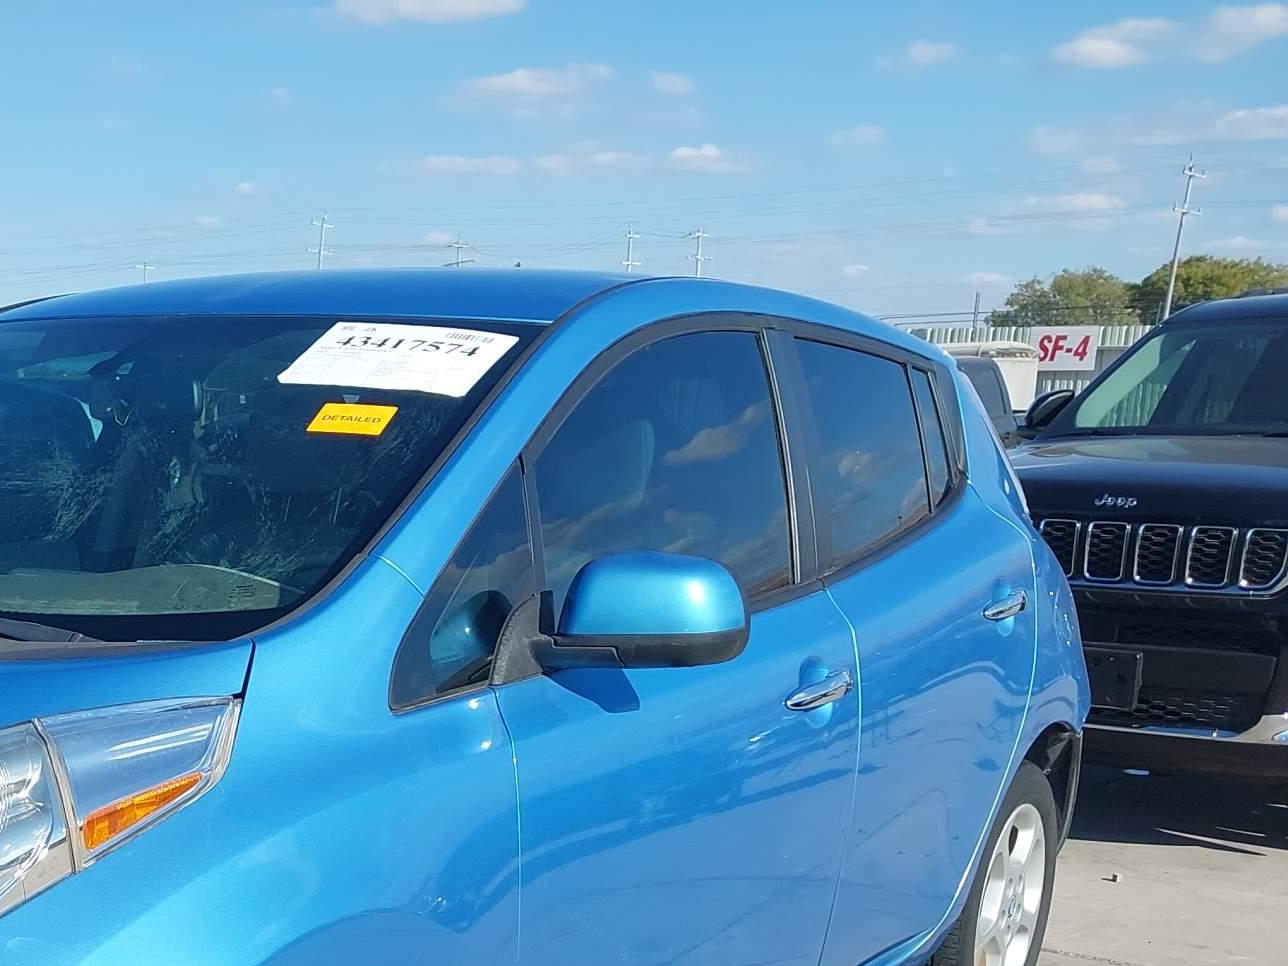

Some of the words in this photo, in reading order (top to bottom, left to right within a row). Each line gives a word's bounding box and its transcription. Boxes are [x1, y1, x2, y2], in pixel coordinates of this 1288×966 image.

[335, 335, 481, 357] 43417574
[1038, 334, 1091, 362] SF-4
[321, 414, 382, 423] DETAILED
[1094, 494, 1138, 509] Jeep
